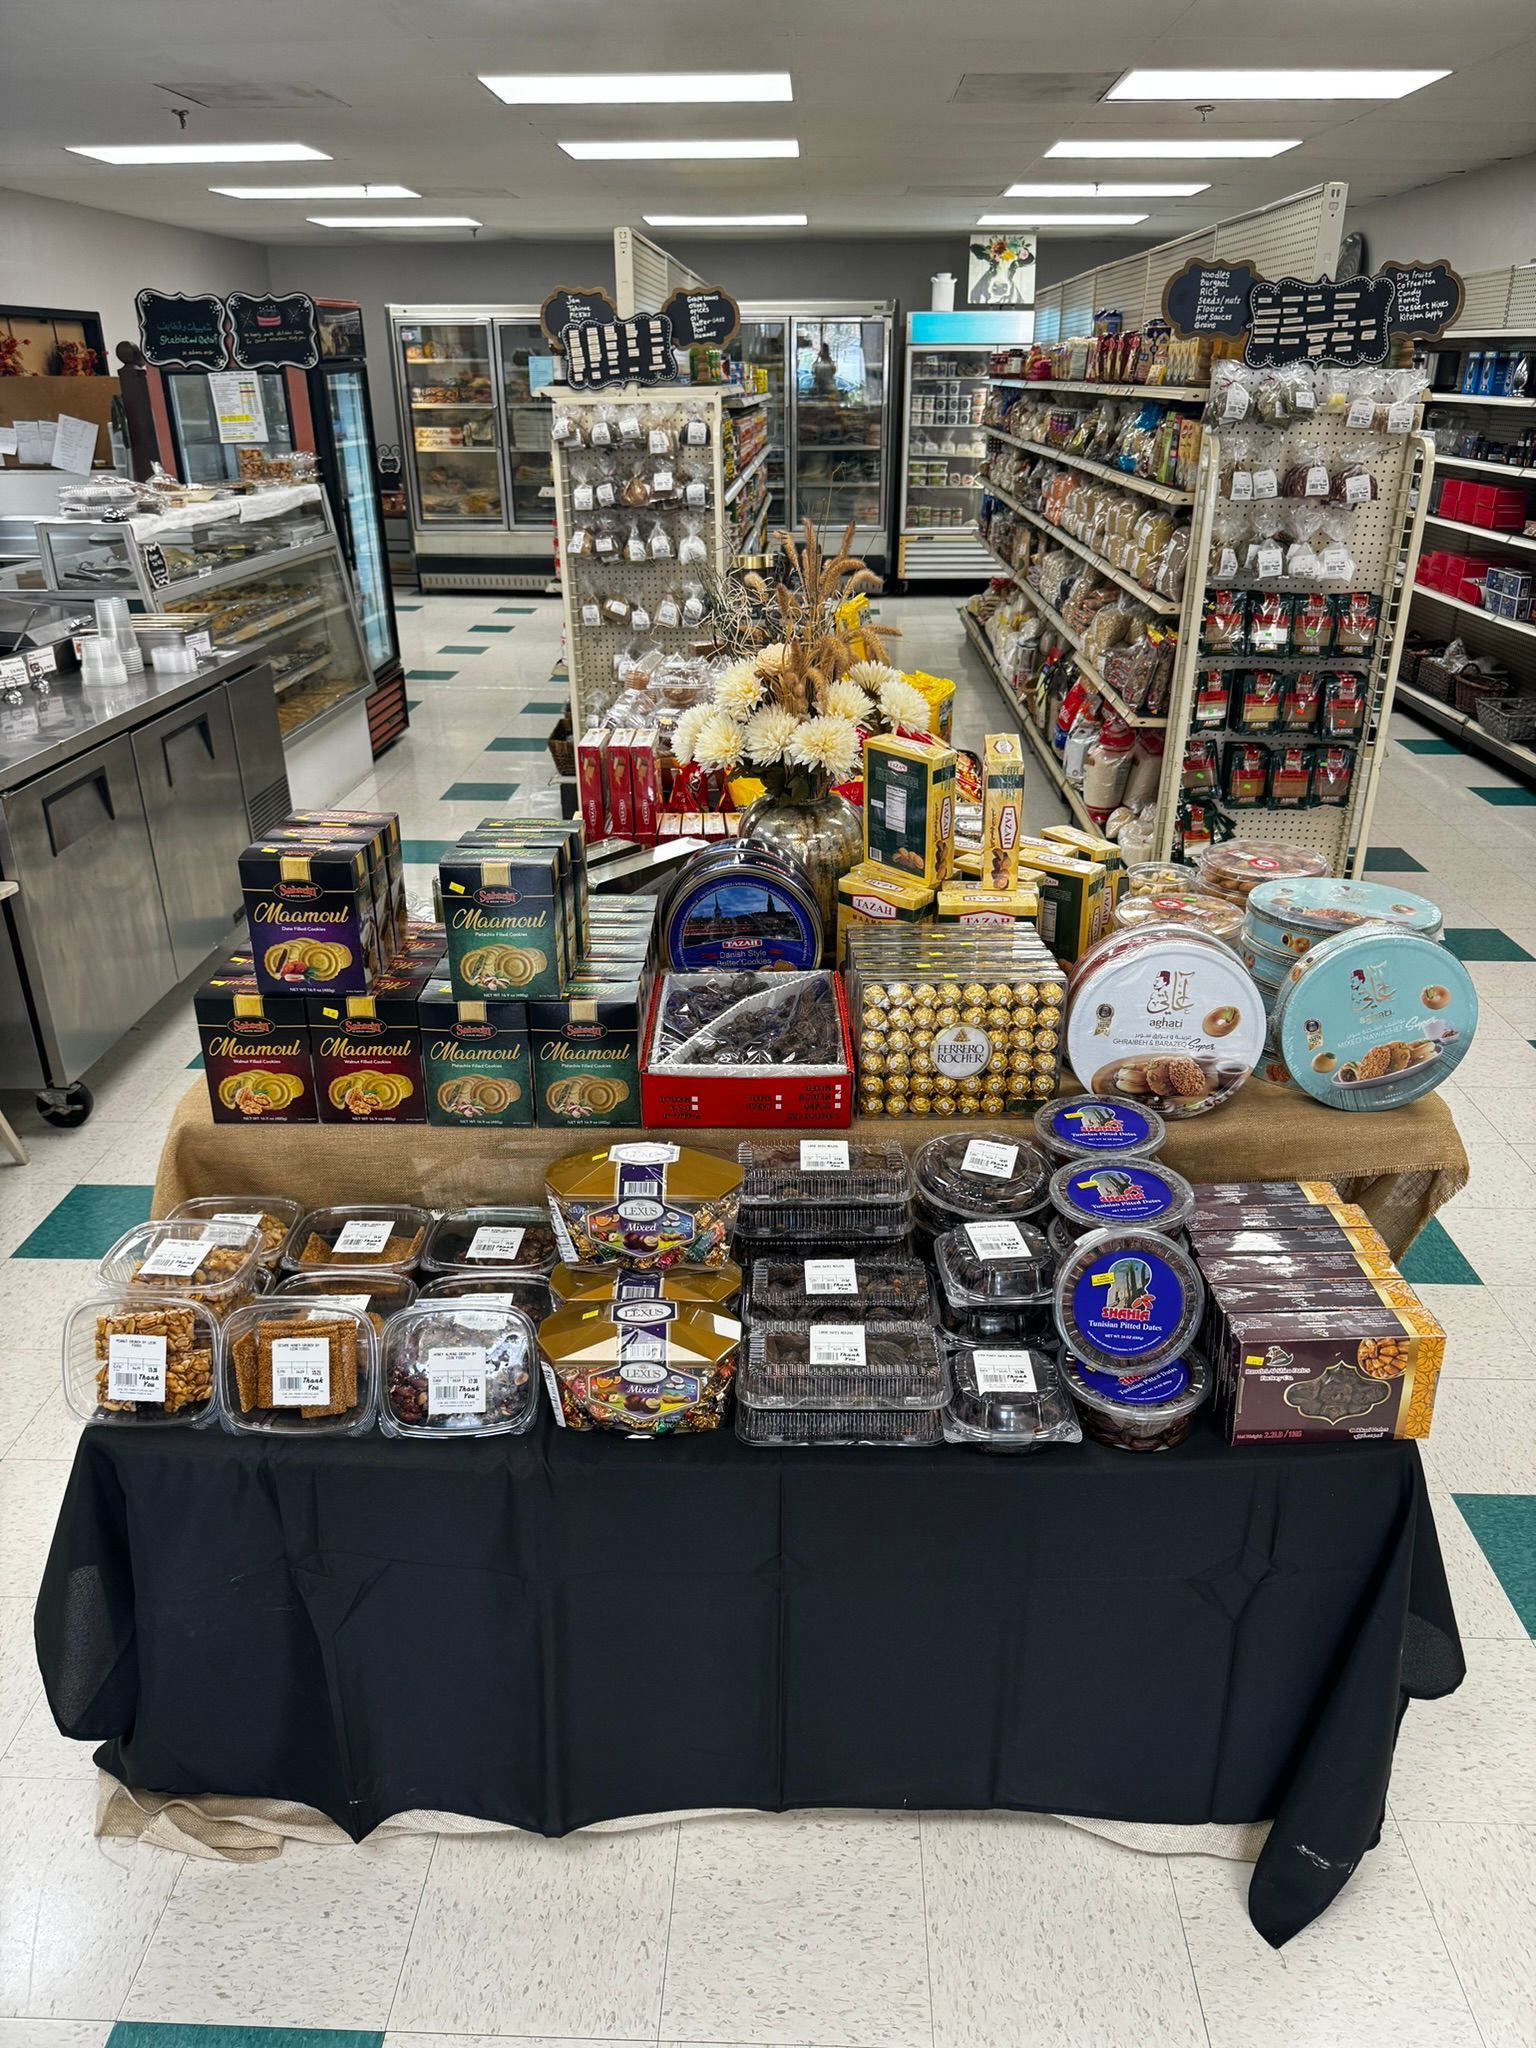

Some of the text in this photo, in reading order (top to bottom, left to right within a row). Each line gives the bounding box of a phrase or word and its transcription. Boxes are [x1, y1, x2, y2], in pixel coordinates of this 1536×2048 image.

[1196, 305, 1225, 313] Flours
[1194, 321, 1217, 329] Grains
[1004, 810, 1013, 845] TAZAH
[856, 898, 892, 916] TAZAH
[254, 902, 349, 925] Maamoul
[452, 908, 547, 931] Maamoul
[727, 939, 758, 948] TAZAH
[720, 949, 767, 959] Danish Style
[740, 958, 771, 966] Cookies
[1149, 1017, 1183, 1029] aghati
[208, 1037, 300, 1058] Maamoul
[320, 1037, 411, 1058] Maamoul
[937, 1044, 985, 1054] FERRERO
[1187, 1038, 1216, 1051] Super
[430, 1041, 521, 1062] Maamoul
[540, 1041, 630, 1062] Maamoul
[937, 1053, 983, 1064] ROCHER
[623, 1206, 658, 1216] LEXUS
[626, 1222, 657, 1232] Mixed
[624, 1307, 664, 1318] LEXUS
[1101, 1307, 1151, 1322] SHAHIA
[1088, 1320, 1162, 1331] Tunisian Pitted Dates
[626, 1369, 661, 1379] LEXUS
[1118, 1380, 1144, 1396] Tunisian
[1144, 1373, 1161, 1385] Pitted
[1161, 1367, 1179, 1378] Dates
[627, 1384, 660, 1394] Mixed
